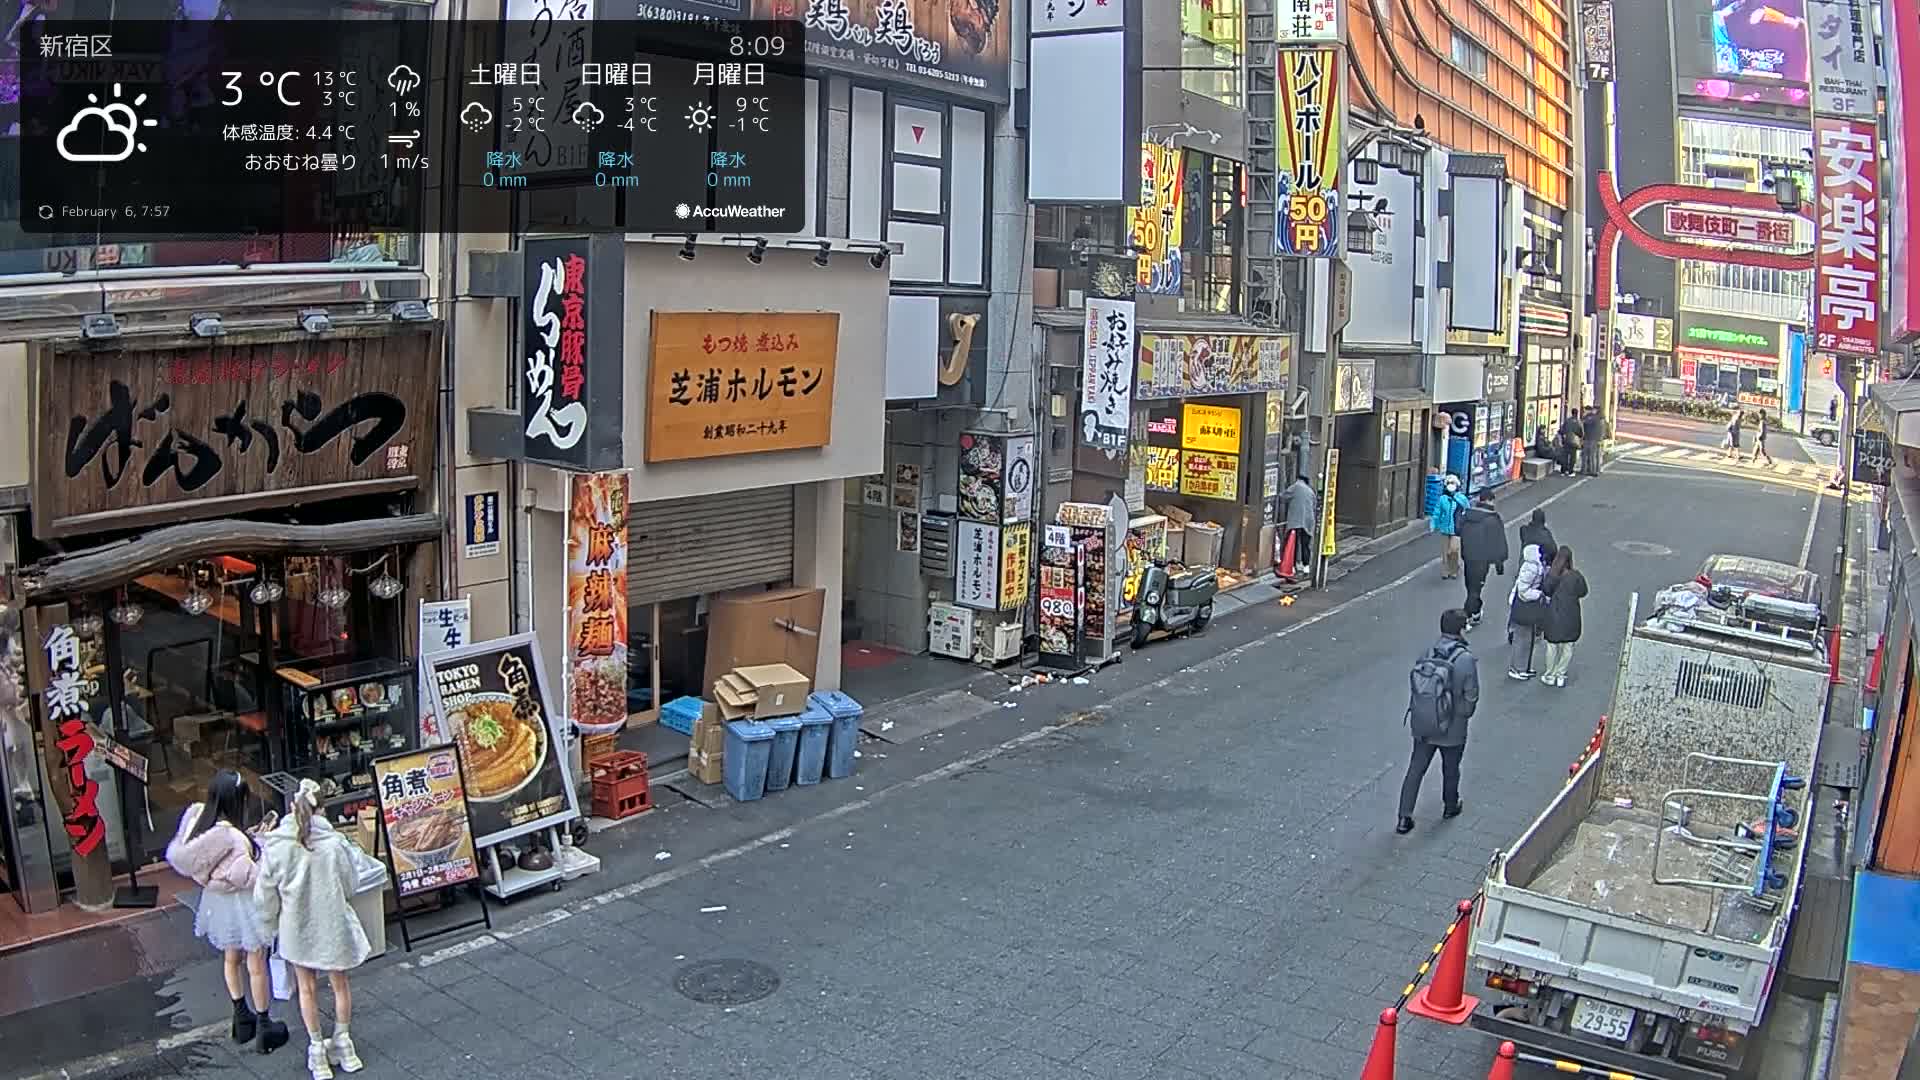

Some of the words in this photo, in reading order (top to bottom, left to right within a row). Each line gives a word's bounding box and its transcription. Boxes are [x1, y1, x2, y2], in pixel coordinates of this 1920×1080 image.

[1817, 14, 1844, 71] タイ
[1589, 63, 1610, 80] 7F
[1832, 97, 1857, 111] 3F
[1295, 51, 1322, 191] ハイボール
[1160, 151, 1175, 288] ハイボール
[1289, 194, 1327, 223] 50
[1133, 220, 1157, 251] 50
[1294, 222, 1320, 251] 円
[1669, 210, 1791, 243] 歌舞伎町一番街
[1819, 126, 1877, 330] 安楽亭
[1136, 254, 1153, 288] 円
[560, 253, 586, 400] 東京豚骨
[1818, 333, 1838, 348] 2F
[702, 332, 749, 354] もつ焼
[755, 331, 800, 353] 煮込み
[1100, 309, 1130, 415] お好み焼き
[668, 365, 823, 406] 芝浦ホルモン
[703, 419, 788, 440] 創業昭和二十九年
[972, 527, 984, 601] 芝浦ホルモン
[578, 521, 616, 657] 麻辣麺
[1041, 599, 1073, 617] 980
[436, 663, 480, 683] TOKYO
[439, 676, 482, 697] RAMEN
[441, 692, 473, 709] SHOP
[43, 623, 106, 857] 角煮ラーメン
[382, 767, 431, 802] 角煮
[1583, 1012, 1630, 1038] 29-55
[1696, 1046, 1728, 1062] FUSO
